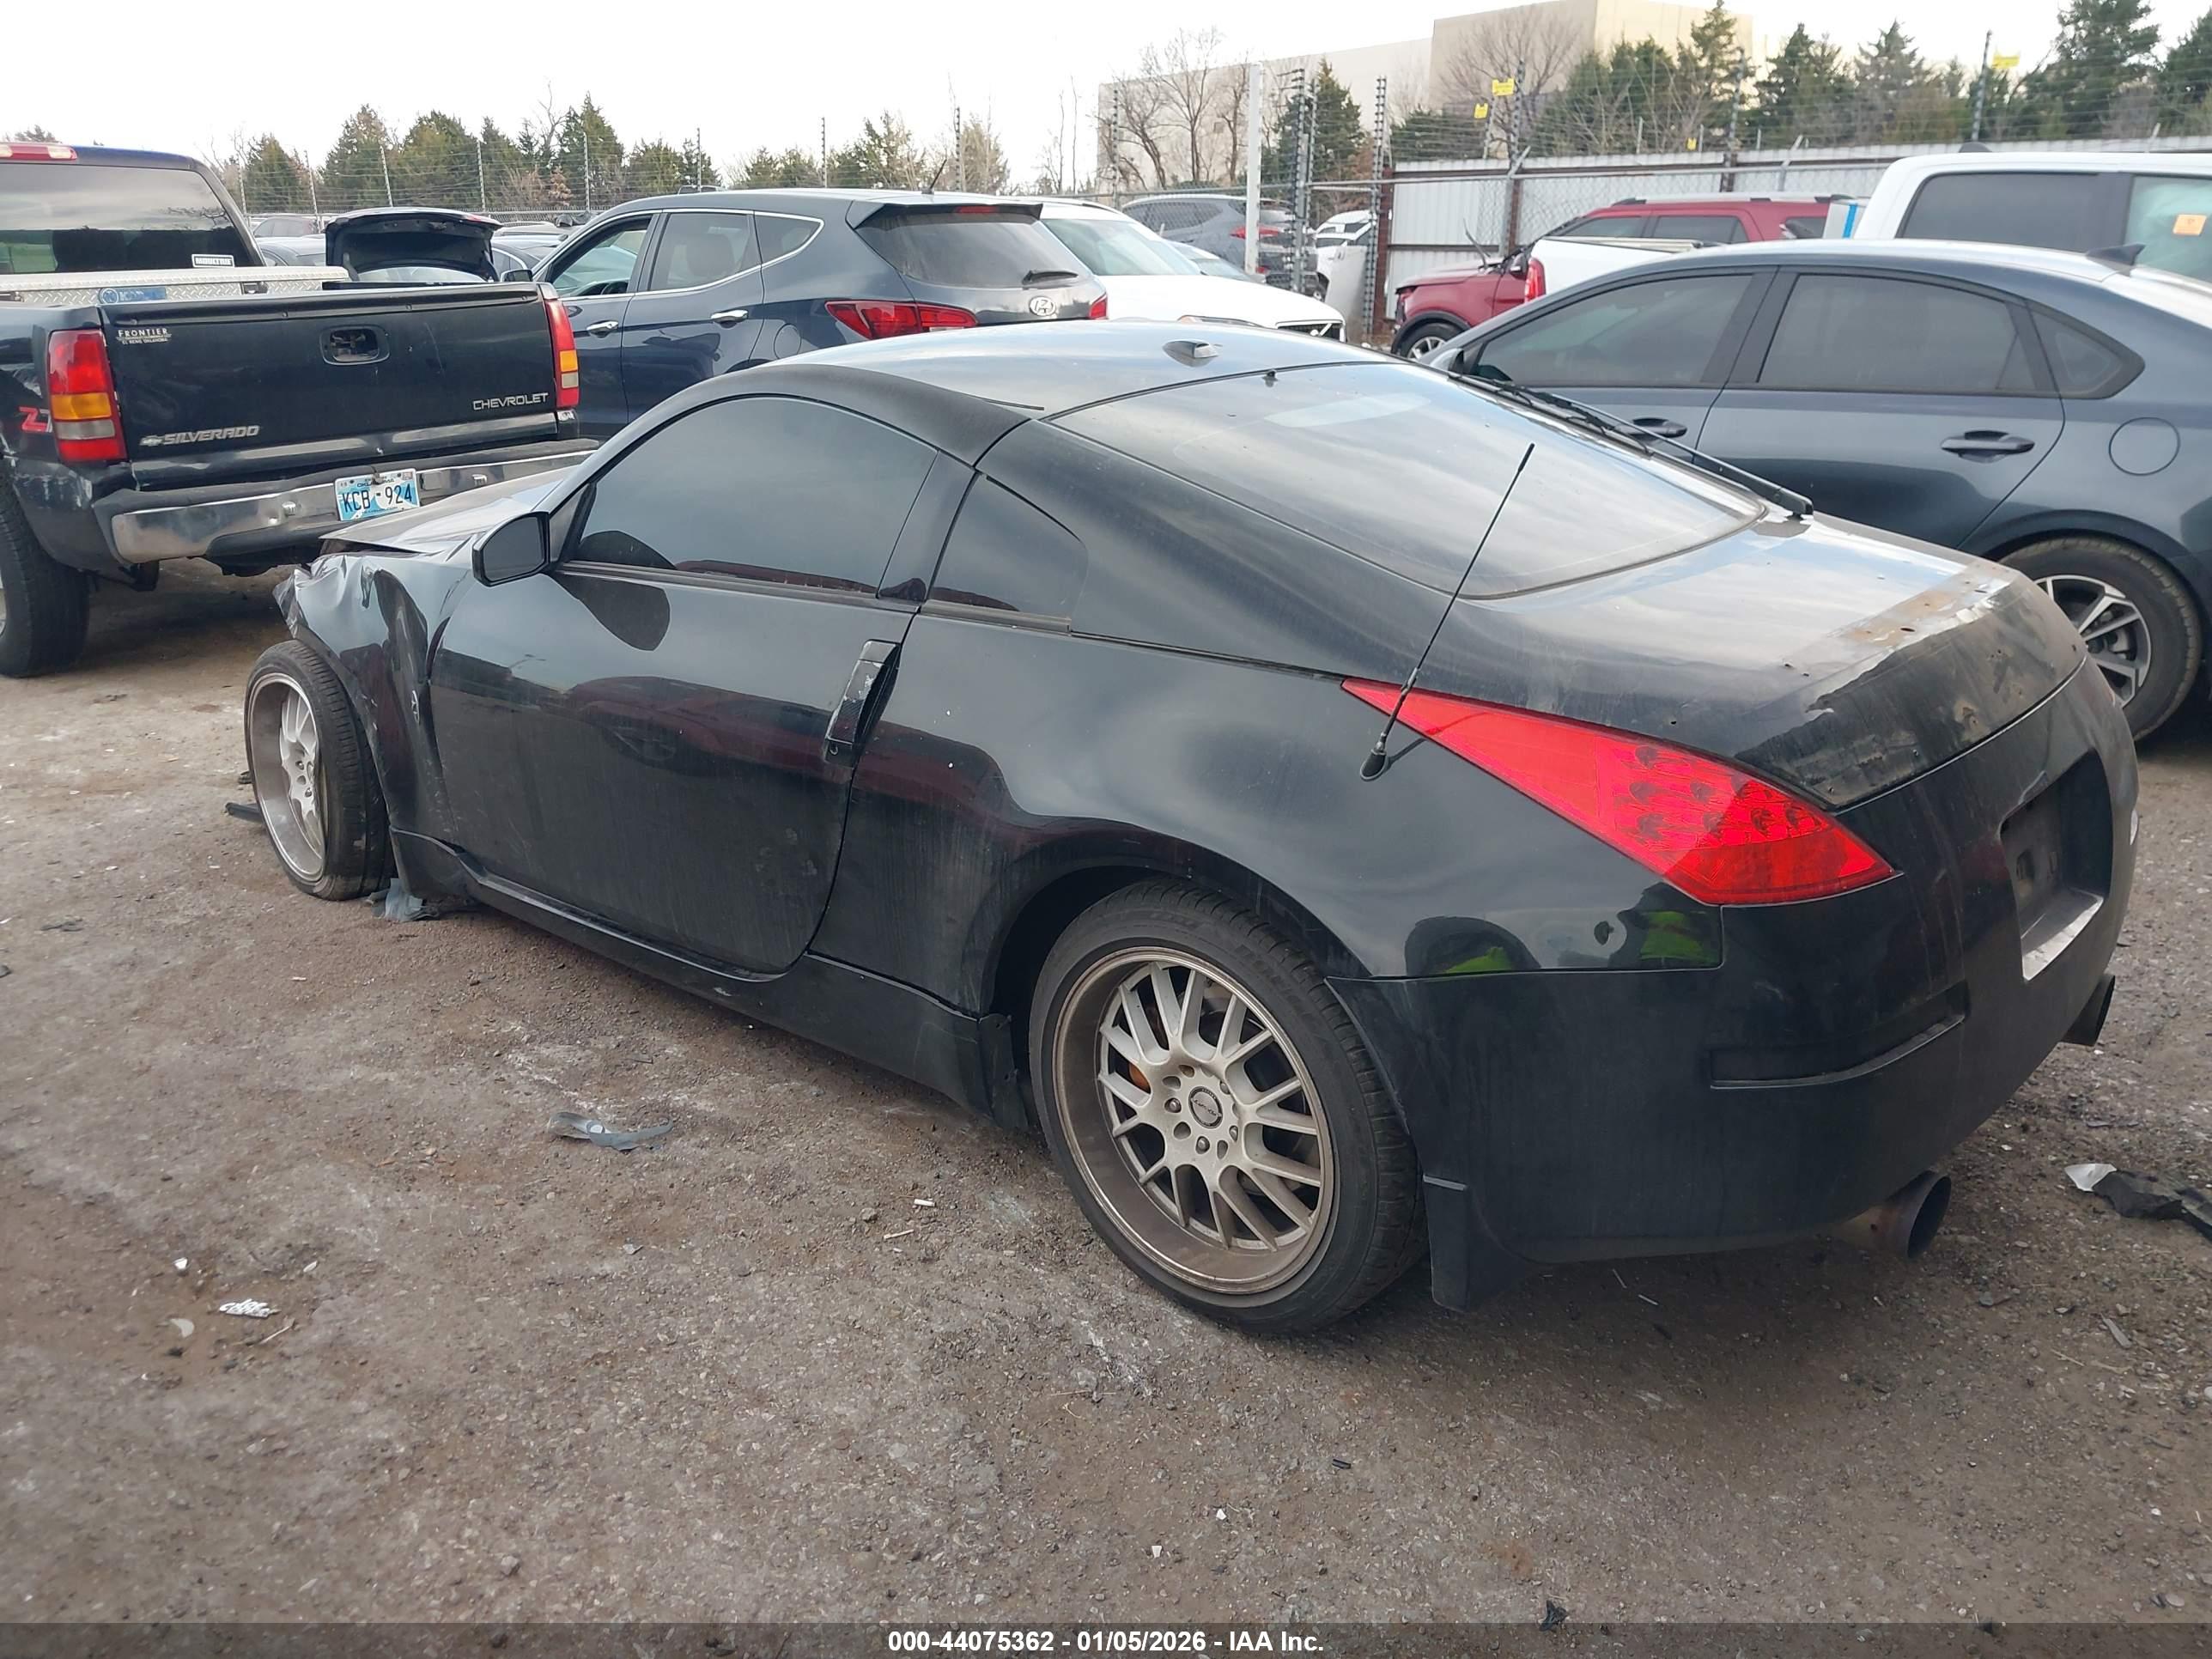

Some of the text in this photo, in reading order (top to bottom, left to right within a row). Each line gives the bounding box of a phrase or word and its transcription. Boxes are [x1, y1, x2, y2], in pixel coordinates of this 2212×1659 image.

[118, 327, 168, 337] FRONTIER
[472, 392, 549, 410] CHEVROLET
[163, 425, 259, 445] SILVERADO
